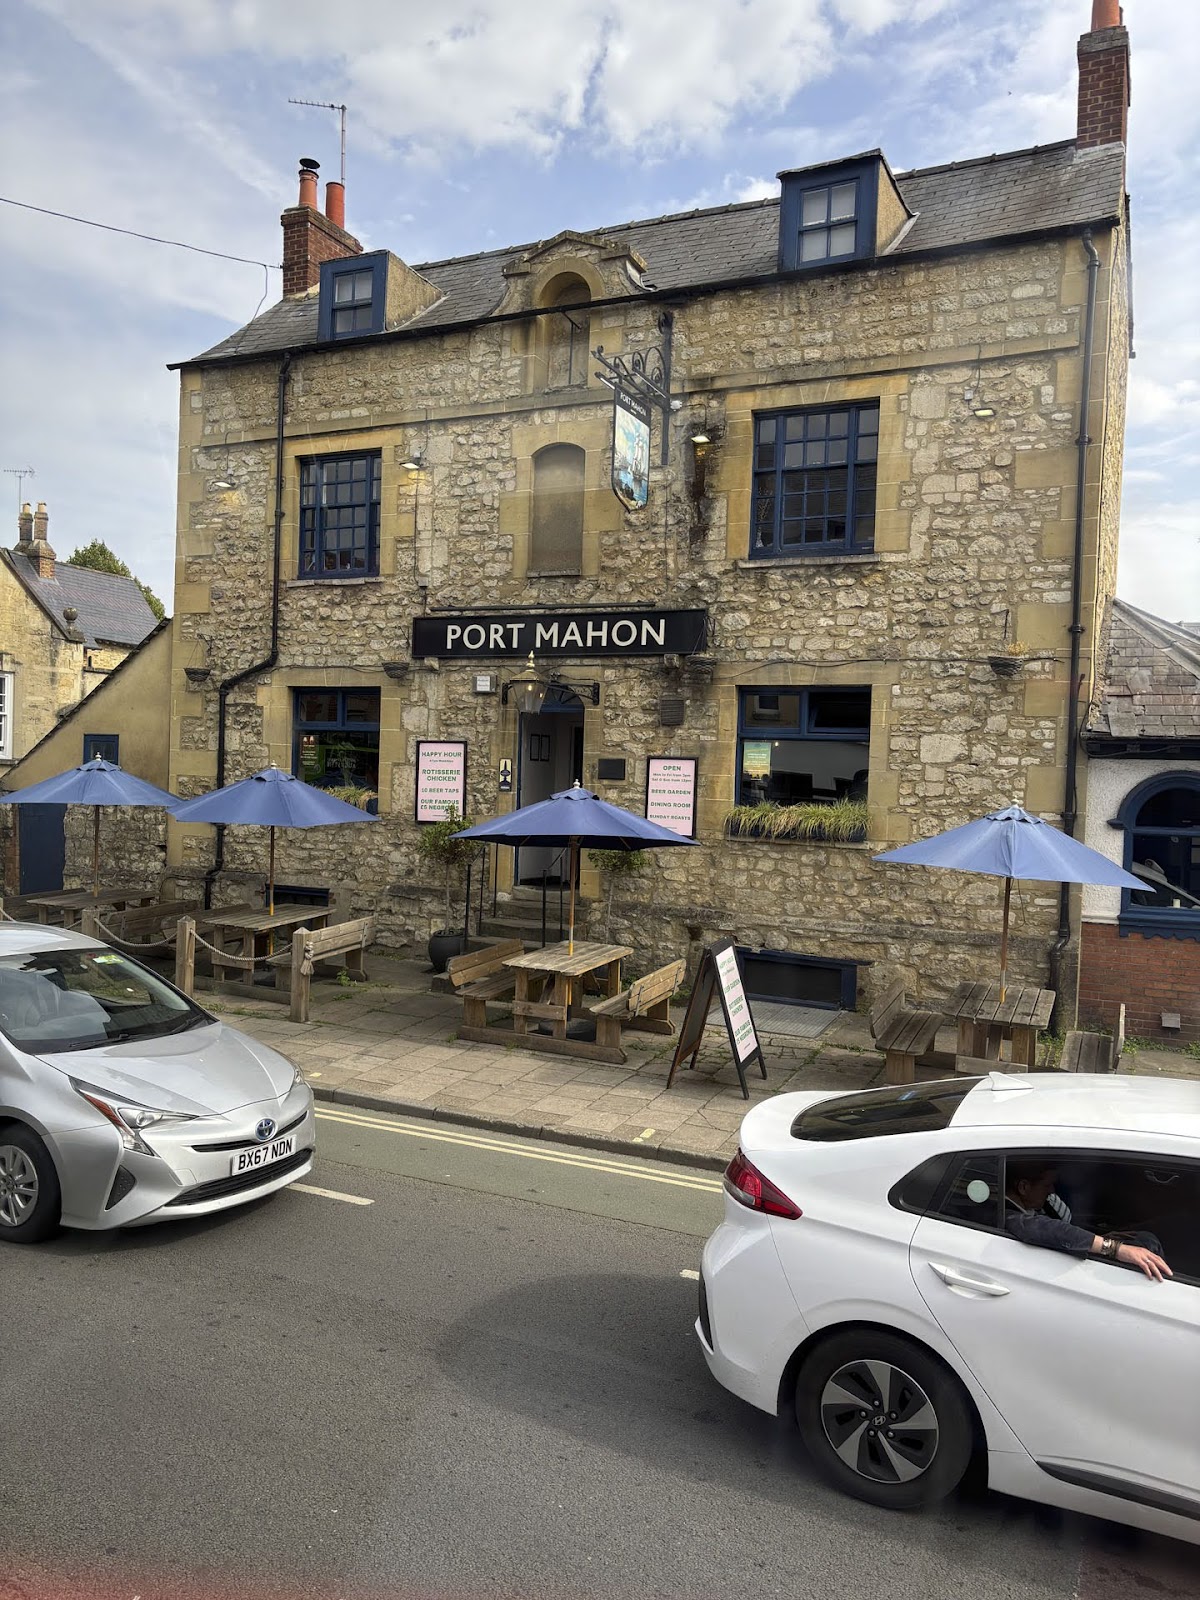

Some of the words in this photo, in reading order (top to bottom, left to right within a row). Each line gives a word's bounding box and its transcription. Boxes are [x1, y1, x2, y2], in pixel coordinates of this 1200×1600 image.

[620, 392, 631, 405] PORT
[631, 400, 647, 416] MAHON
[446, 623, 525, 650] PORT
[535, 618, 666, 649] MAHON
[238, 1147, 269, 1170] BX67
[271, 1138, 293, 1159] NDN
